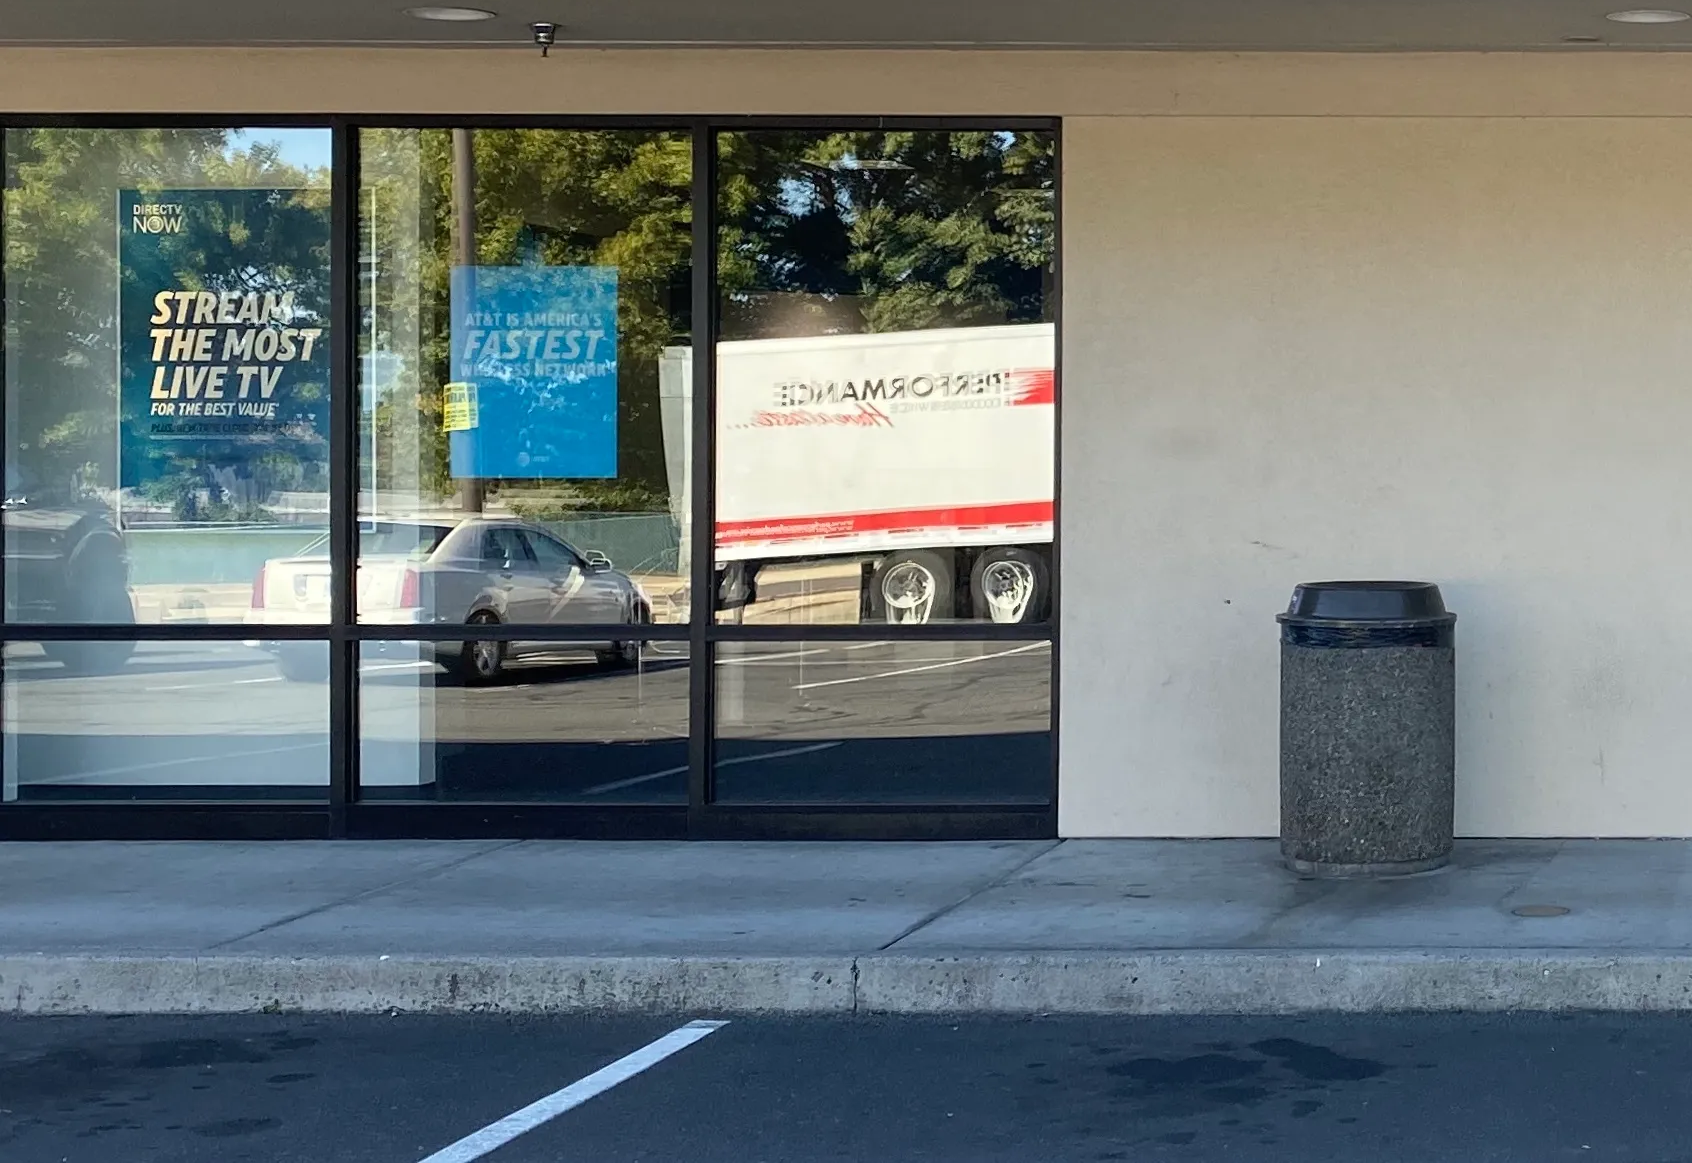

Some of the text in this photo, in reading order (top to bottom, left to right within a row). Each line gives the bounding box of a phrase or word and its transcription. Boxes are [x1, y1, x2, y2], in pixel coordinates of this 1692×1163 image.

[133, 204, 183, 215] DIRECTV
[133, 215, 183, 234] NOW
[150, 290, 296, 325] STREAM
[464, 312, 602, 327] AT&T IS AMERICA'S
[150, 328, 323, 362] THE MOST
[463, 329, 605, 360] FASTEST
[149, 365, 284, 399] LIVE TV
[150, 402, 176, 417] FOR
[178, 402, 203, 417] THE
[204, 402, 236, 417] BEST
